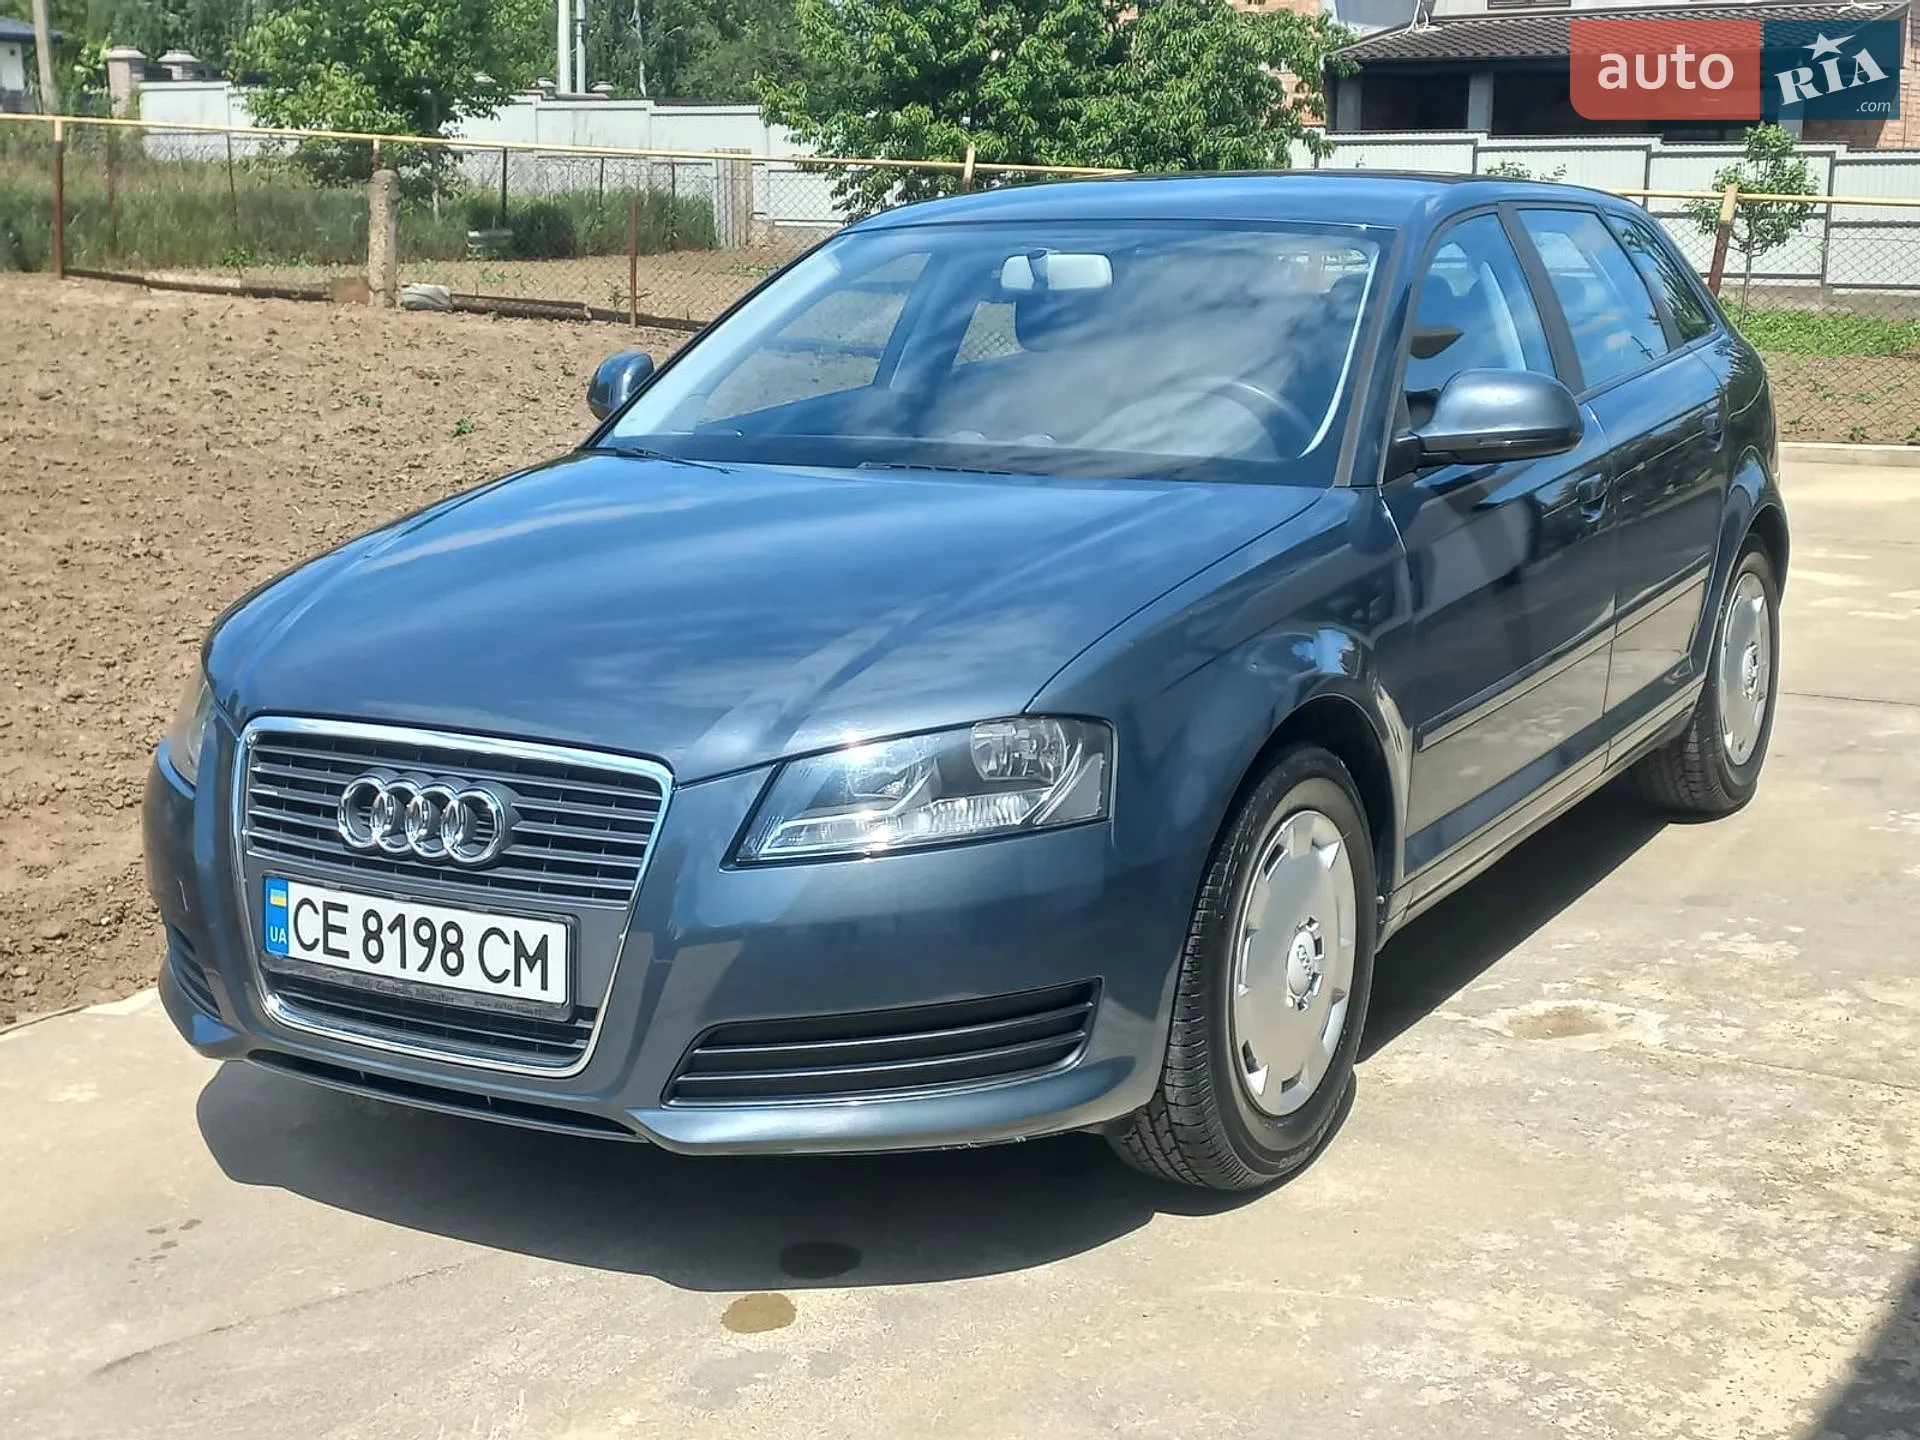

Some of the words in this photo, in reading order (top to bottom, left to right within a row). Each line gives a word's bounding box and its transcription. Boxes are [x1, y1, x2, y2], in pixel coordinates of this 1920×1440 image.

[269, 925, 287, 944] UA
[293, 897, 349, 959] CE
[361, 908, 464, 977] 8198
[477, 926, 548, 991] CM
